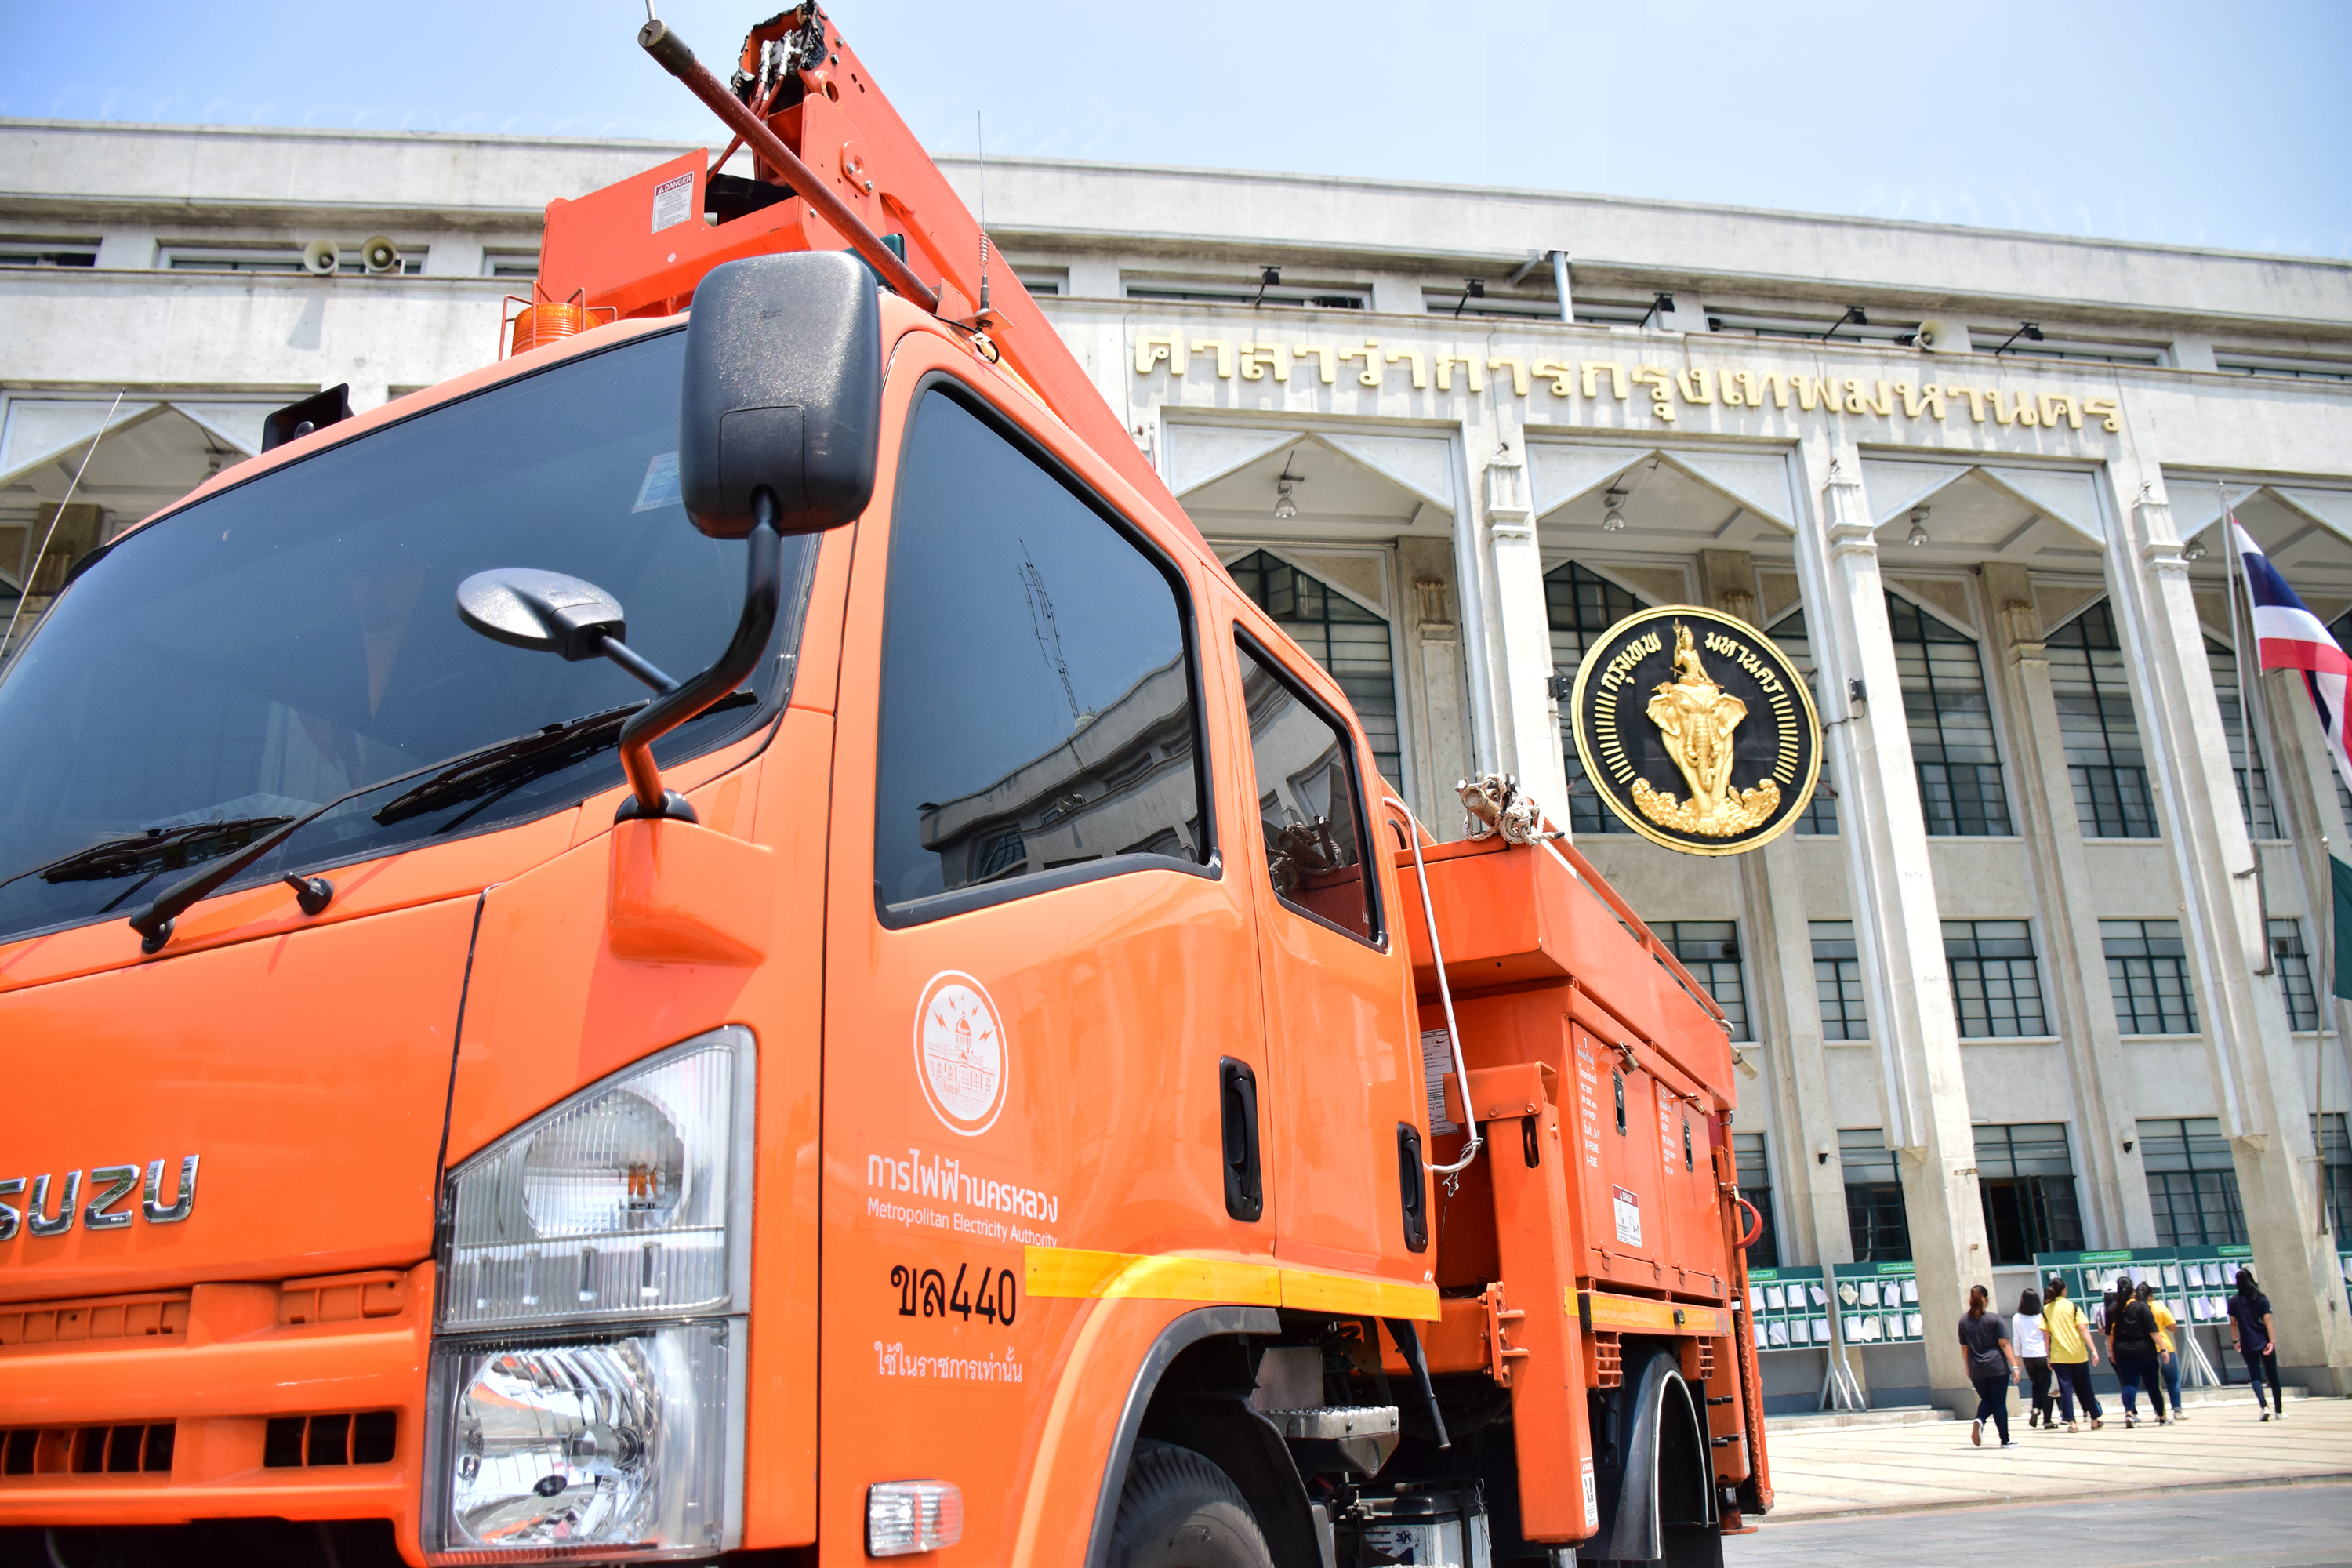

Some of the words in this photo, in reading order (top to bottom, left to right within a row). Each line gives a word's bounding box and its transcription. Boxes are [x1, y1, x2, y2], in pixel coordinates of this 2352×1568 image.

[665, 175, 691, 191] DANGER
[1134, 331, 2121, 433] ศาลาว่าการกรุงเทพมหานคร
[1600, 630, 1662, 692] กรุงเทพ
[1704, 630, 1785, 693] มหานคร
[1662, 1088, 1667, 1098] 2
[867, 1147, 1058, 1223] การไฟฟ้านครหลวง
[867, 1196, 949, 1228] Metropolitan
[953, 1212, 1008, 1243] Electricity
[1010, 1224, 1058, 1248] Authority
[890, 1262, 1017, 1327] ขล440
[874, 1340, 1022, 1383] ใช้ในราชการเท่านั้น
[1395, 1530, 1412, 1544] 3K
